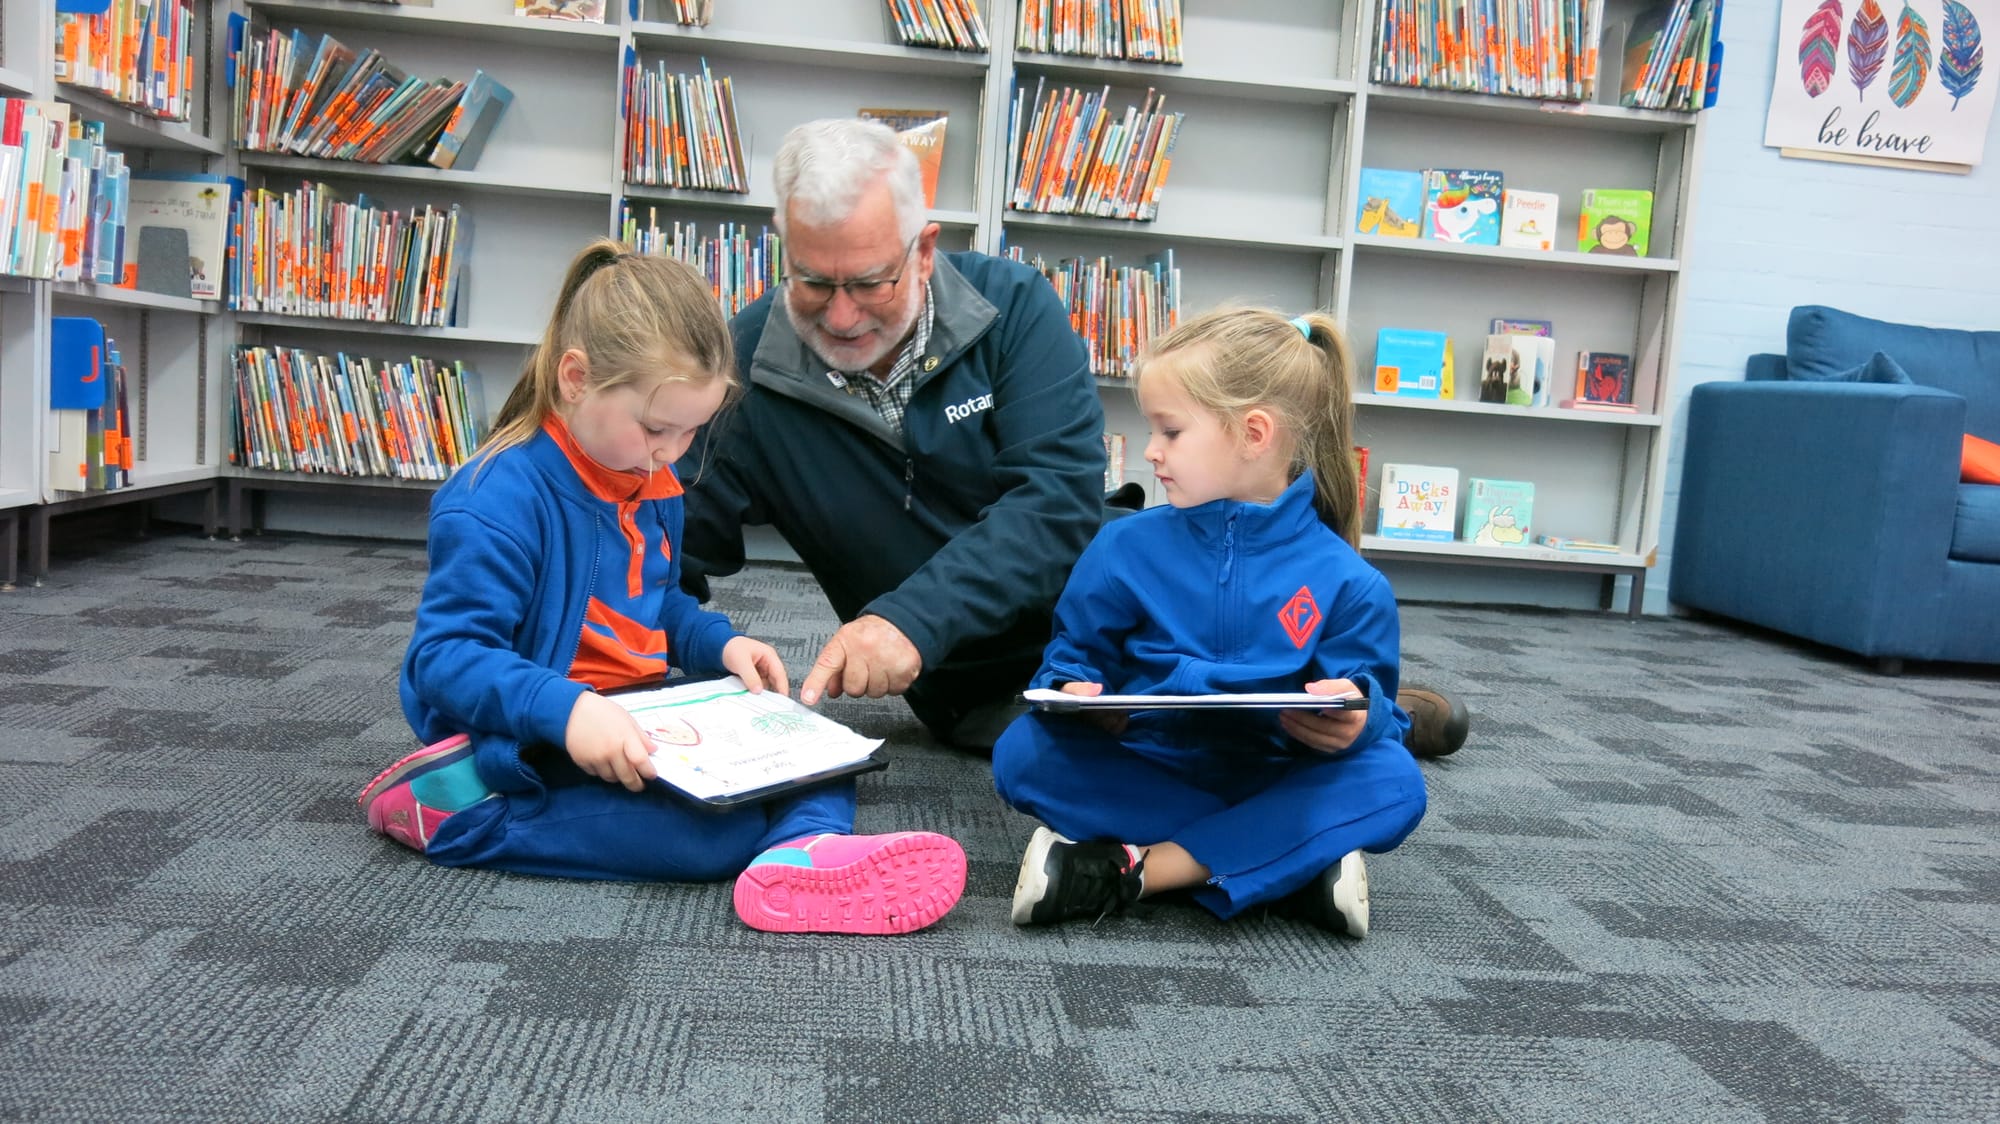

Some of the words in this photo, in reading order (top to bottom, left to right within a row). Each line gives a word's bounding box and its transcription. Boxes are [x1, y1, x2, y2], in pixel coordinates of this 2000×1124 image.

[1817, 106, 1849, 146] be
[1856, 110, 1933, 153] brave
[80, 345, 99, 383] J
[1397, 480, 1449, 497] Ducks
[1396, 495, 1448, 516] Away!
